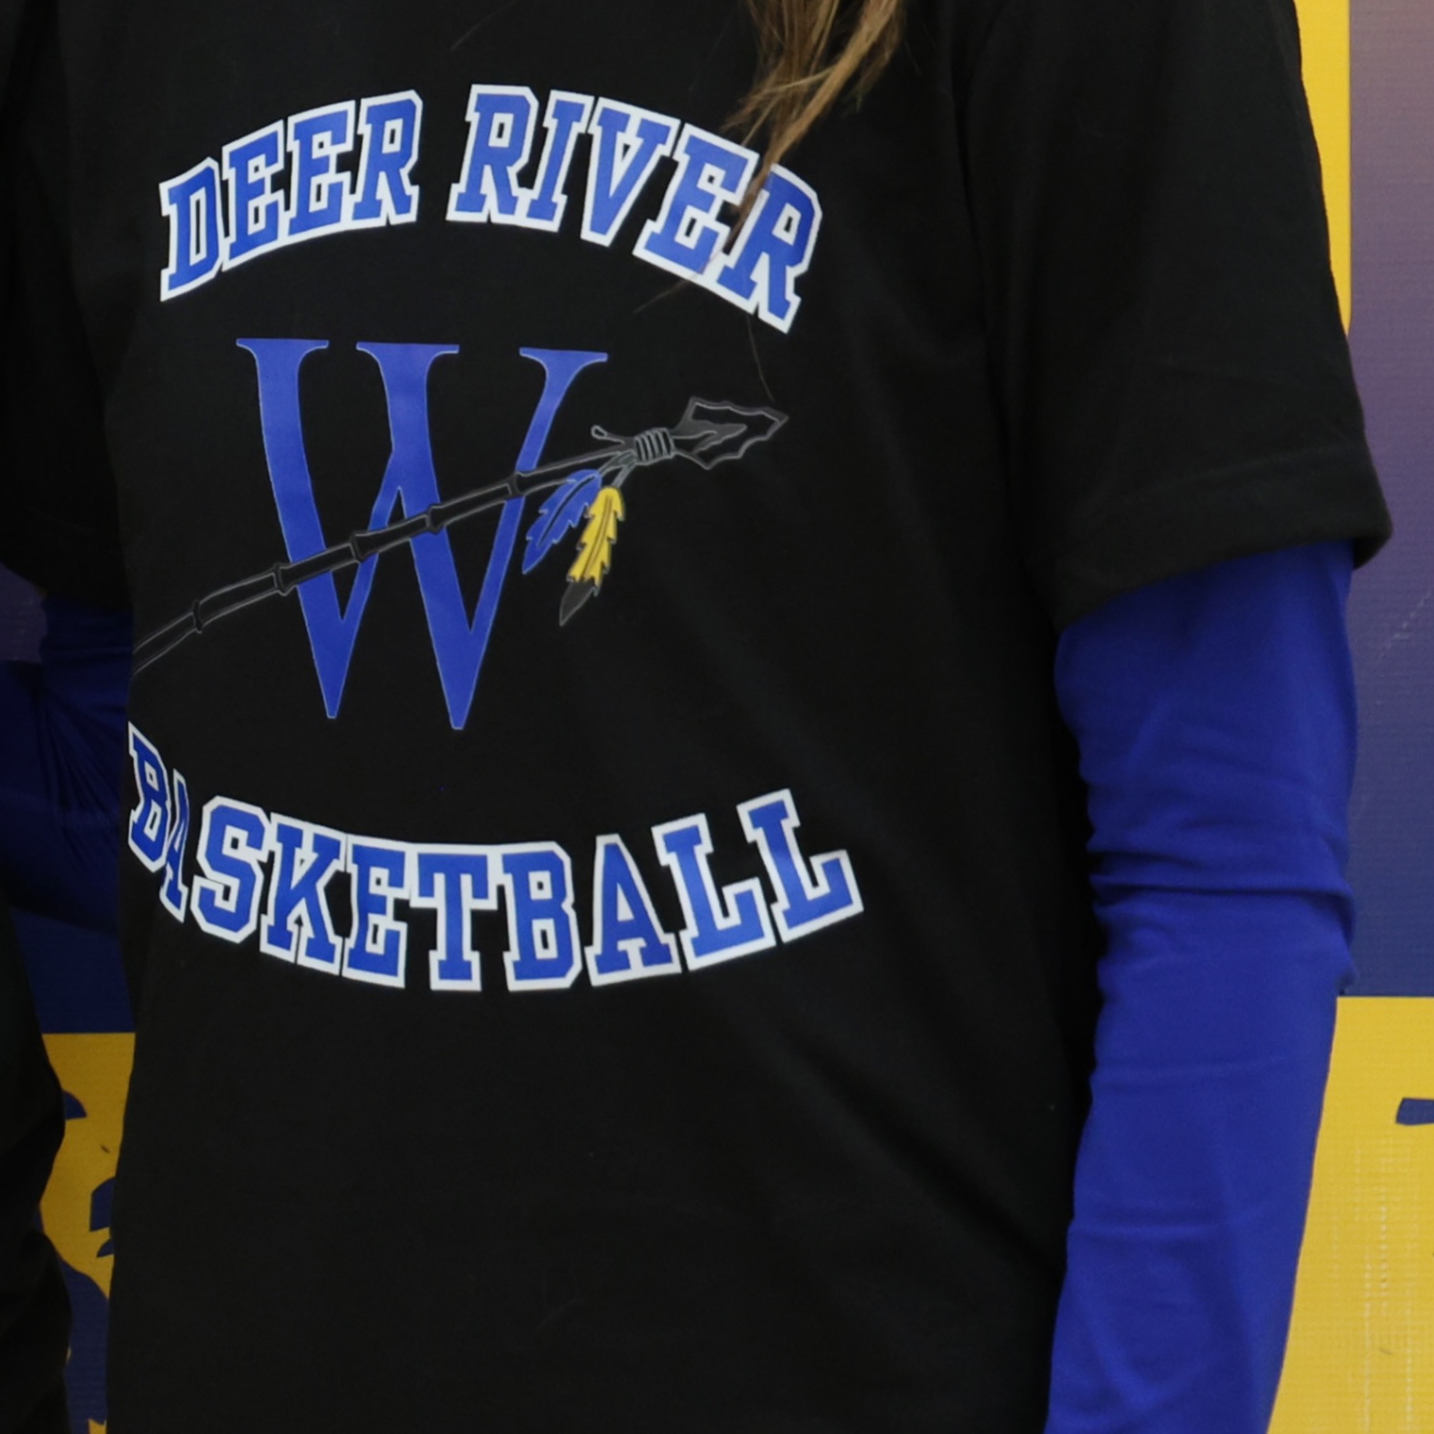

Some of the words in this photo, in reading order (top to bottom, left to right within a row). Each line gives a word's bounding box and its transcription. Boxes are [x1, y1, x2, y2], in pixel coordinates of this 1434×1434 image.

[159, 89, 423, 303] DEER
[445, 83, 824, 335] RIVER
[235, 337, 608, 731] W
[127, 719, 865, 993] BASKETBALL
